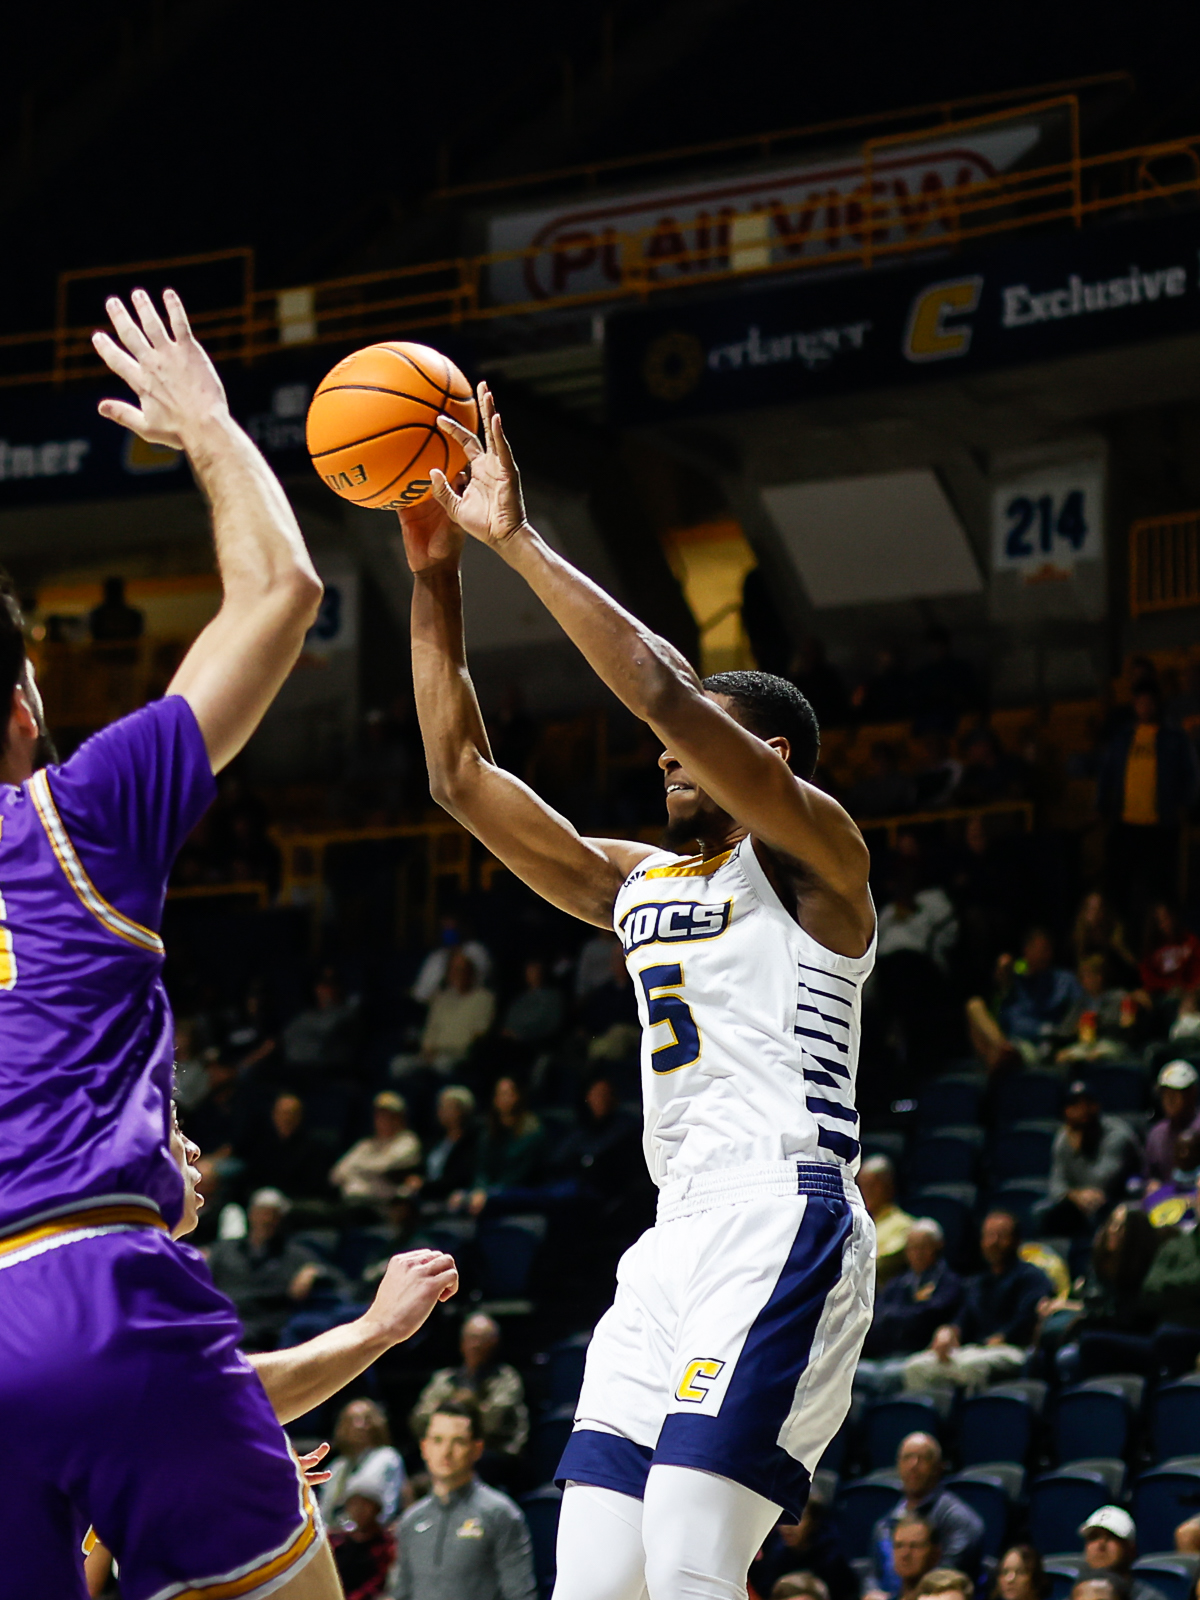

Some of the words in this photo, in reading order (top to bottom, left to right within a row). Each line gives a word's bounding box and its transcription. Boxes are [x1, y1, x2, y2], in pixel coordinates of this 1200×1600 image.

[707, 320, 874, 372] erlanger
[1002, 264, 1187, 329] Exclusive
[1006, 491, 1086, 556] 214
[639, 962, 702, 1076] 5
